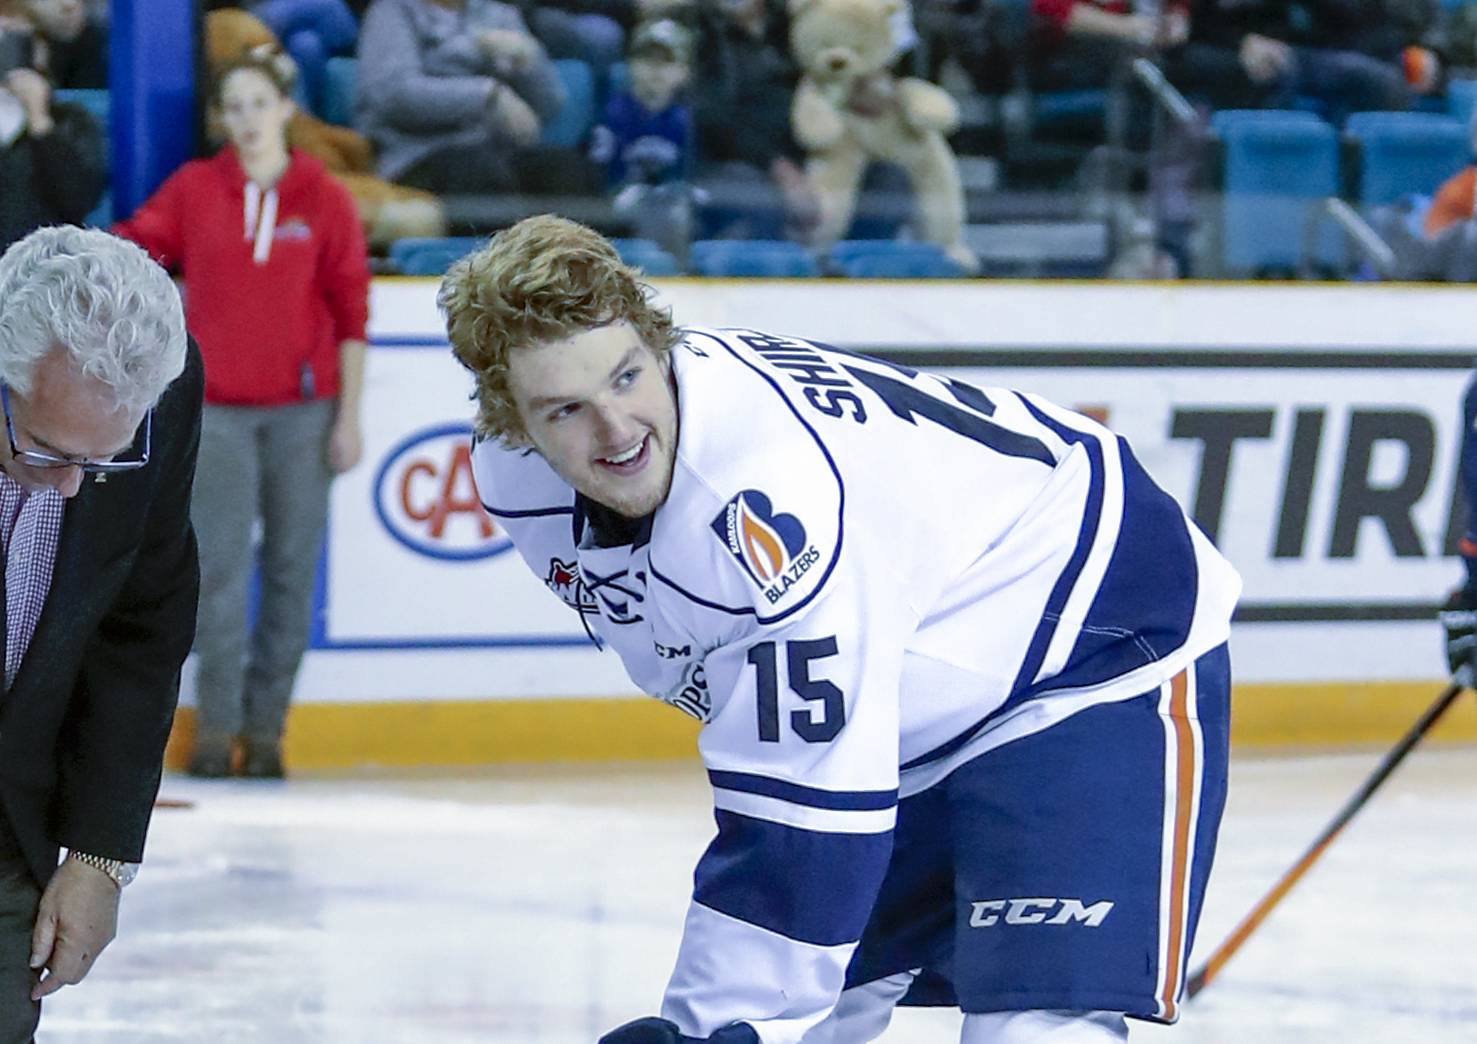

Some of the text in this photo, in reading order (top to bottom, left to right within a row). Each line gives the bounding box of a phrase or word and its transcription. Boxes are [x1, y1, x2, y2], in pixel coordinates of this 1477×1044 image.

[764, 545, 821, 605] BLAZERS
[747, 634, 846, 743] 15
[968, 897, 1115, 928] CCM
